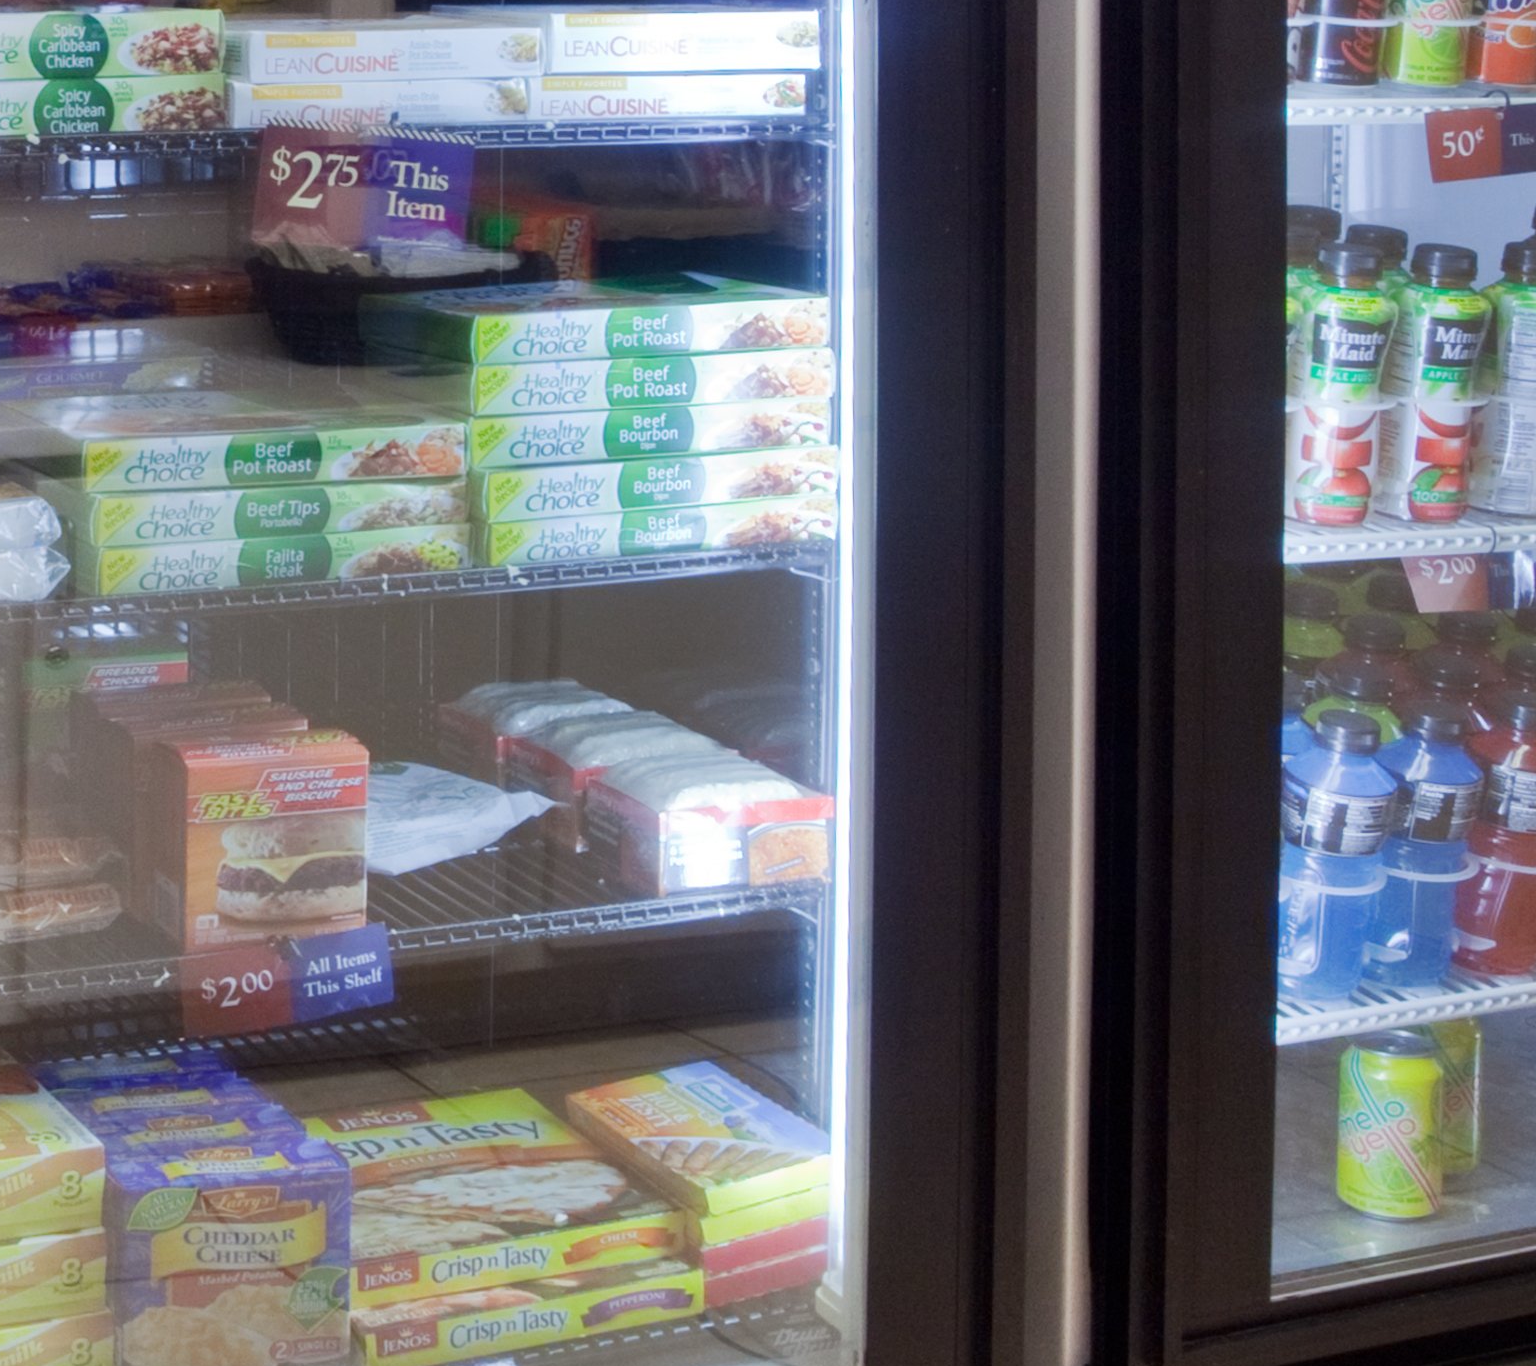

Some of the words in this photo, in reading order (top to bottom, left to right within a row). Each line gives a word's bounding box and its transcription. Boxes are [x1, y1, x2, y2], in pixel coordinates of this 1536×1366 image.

[53, 24, 86, 41] Spicy
[38, 38, 100, 54] Caribbean
[45, 55, 94, 70] Chicken
[58, 89, 92, 106] Spicy
[43, 103, 106, 119] Caribbean
[50, 120, 99, 133] Chicken
[1441, 126, 1485, 159] 50¢
[1510, 131, 1535, 146] This
[389, 160, 449, 192] This
[386, 190, 447, 222] Item
[524, 318, 592, 338] Healthy
[633, 314, 668, 330] Beef
[613, 333, 639, 347] Pot
[643, 331, 686, 345] Roast
[1320, 324, 1385, 345] Minute
[512, 338, 587, 356] Choice
[1330, 343, 1375, 362] Maid
[523, 369, 592, 389] Healthy
[633, 365, 670, 381] Beef
[512, 389, 587, 407] Choice
[613, 384, 639, 398] Pot
[644, 382, 688, 396] Roast
[521, 420, 590, 440] Healthy
[633, 413, 666, 429] Beef
[619, 429, 678, 443] Bourbon
[138, 445, 211, 467] Healthy
[255, 442, 294, 458] Beef
[509, 440, 584, 459] Choice
[124, 465, 205, 484] Choice
[233, 460, 260, 475] Pot
[267, 459, 313, 473] Roast
[647, 464, 680, 480] Beef
[538, 472, 605, 493] Healthy
[634, 479, 691, 494] Bourbon
[150, 500, 222, 521] Healthy
[246, 501, 285, 517] Beef
[288, 500, 321, 517] Tips
[525, 493, 600, 512] Choice
[135, 520, 215, 540] Choice
[648, 514, 680, 530] Beef
[539, 522, 607, 544] Healthy
[634, 528, 691, 544] Bourbon
[266, 549, 305, 566] Fajita
[527, 542, 600, 561] Choice
[152, 550, 224, 572] Healthy
[265, 563, 303, 579] Steak
[138, 570, 218, 591] Choice
[95, 665, 159, 676] BREADED
[101, 675, 160, 685] CHICKEN
[268, 768, 336, 782] SAUSAGE
[275, 781, 306, 791] AND
[309, 777, 364, 789] CHEESE
[200, 792, 264, 807] FAST
[284, 790, 341, 802] BISCUIT
[203, 805, 272, 819] BITES
[306, 958, 331, 976] All
[335, 949, 377, 969] Items
[303, 979, 340, 998] This
[344, 967, 383, 990] Shelf
[338, 1108, 418, 1130] JENO'S
[424, 1118, 540, 1146] Tasty
[388, 1150, 459, 1168] CHEESE
[62, 1170, 81, 1198] 8
[218, 1192, 273, 1211] Larry's
[184, 1226, 295, 1245] CHEDDAR
[196, 1245, 282, 1263] CHEESE
[363, 1267, 413, 1287] JENO'S
[432, 1257, 484, 1283] Crisp
[501, 1245, 550, 1273] Tasty
[600, 1229, 639, 1245] CHEESE
[61, 1257, 81, 1286] 8
[383, 1334, 432, 1355] JENO'S
[450, 1321, 502, 1347] Crisp
[520, 1308, 569, 1334] Tasty
[610, 1290, 667, 1309] PEPPERONI
[70, 1338, 91, 1366] 8
[275, 1342, 288, 1358] 2
